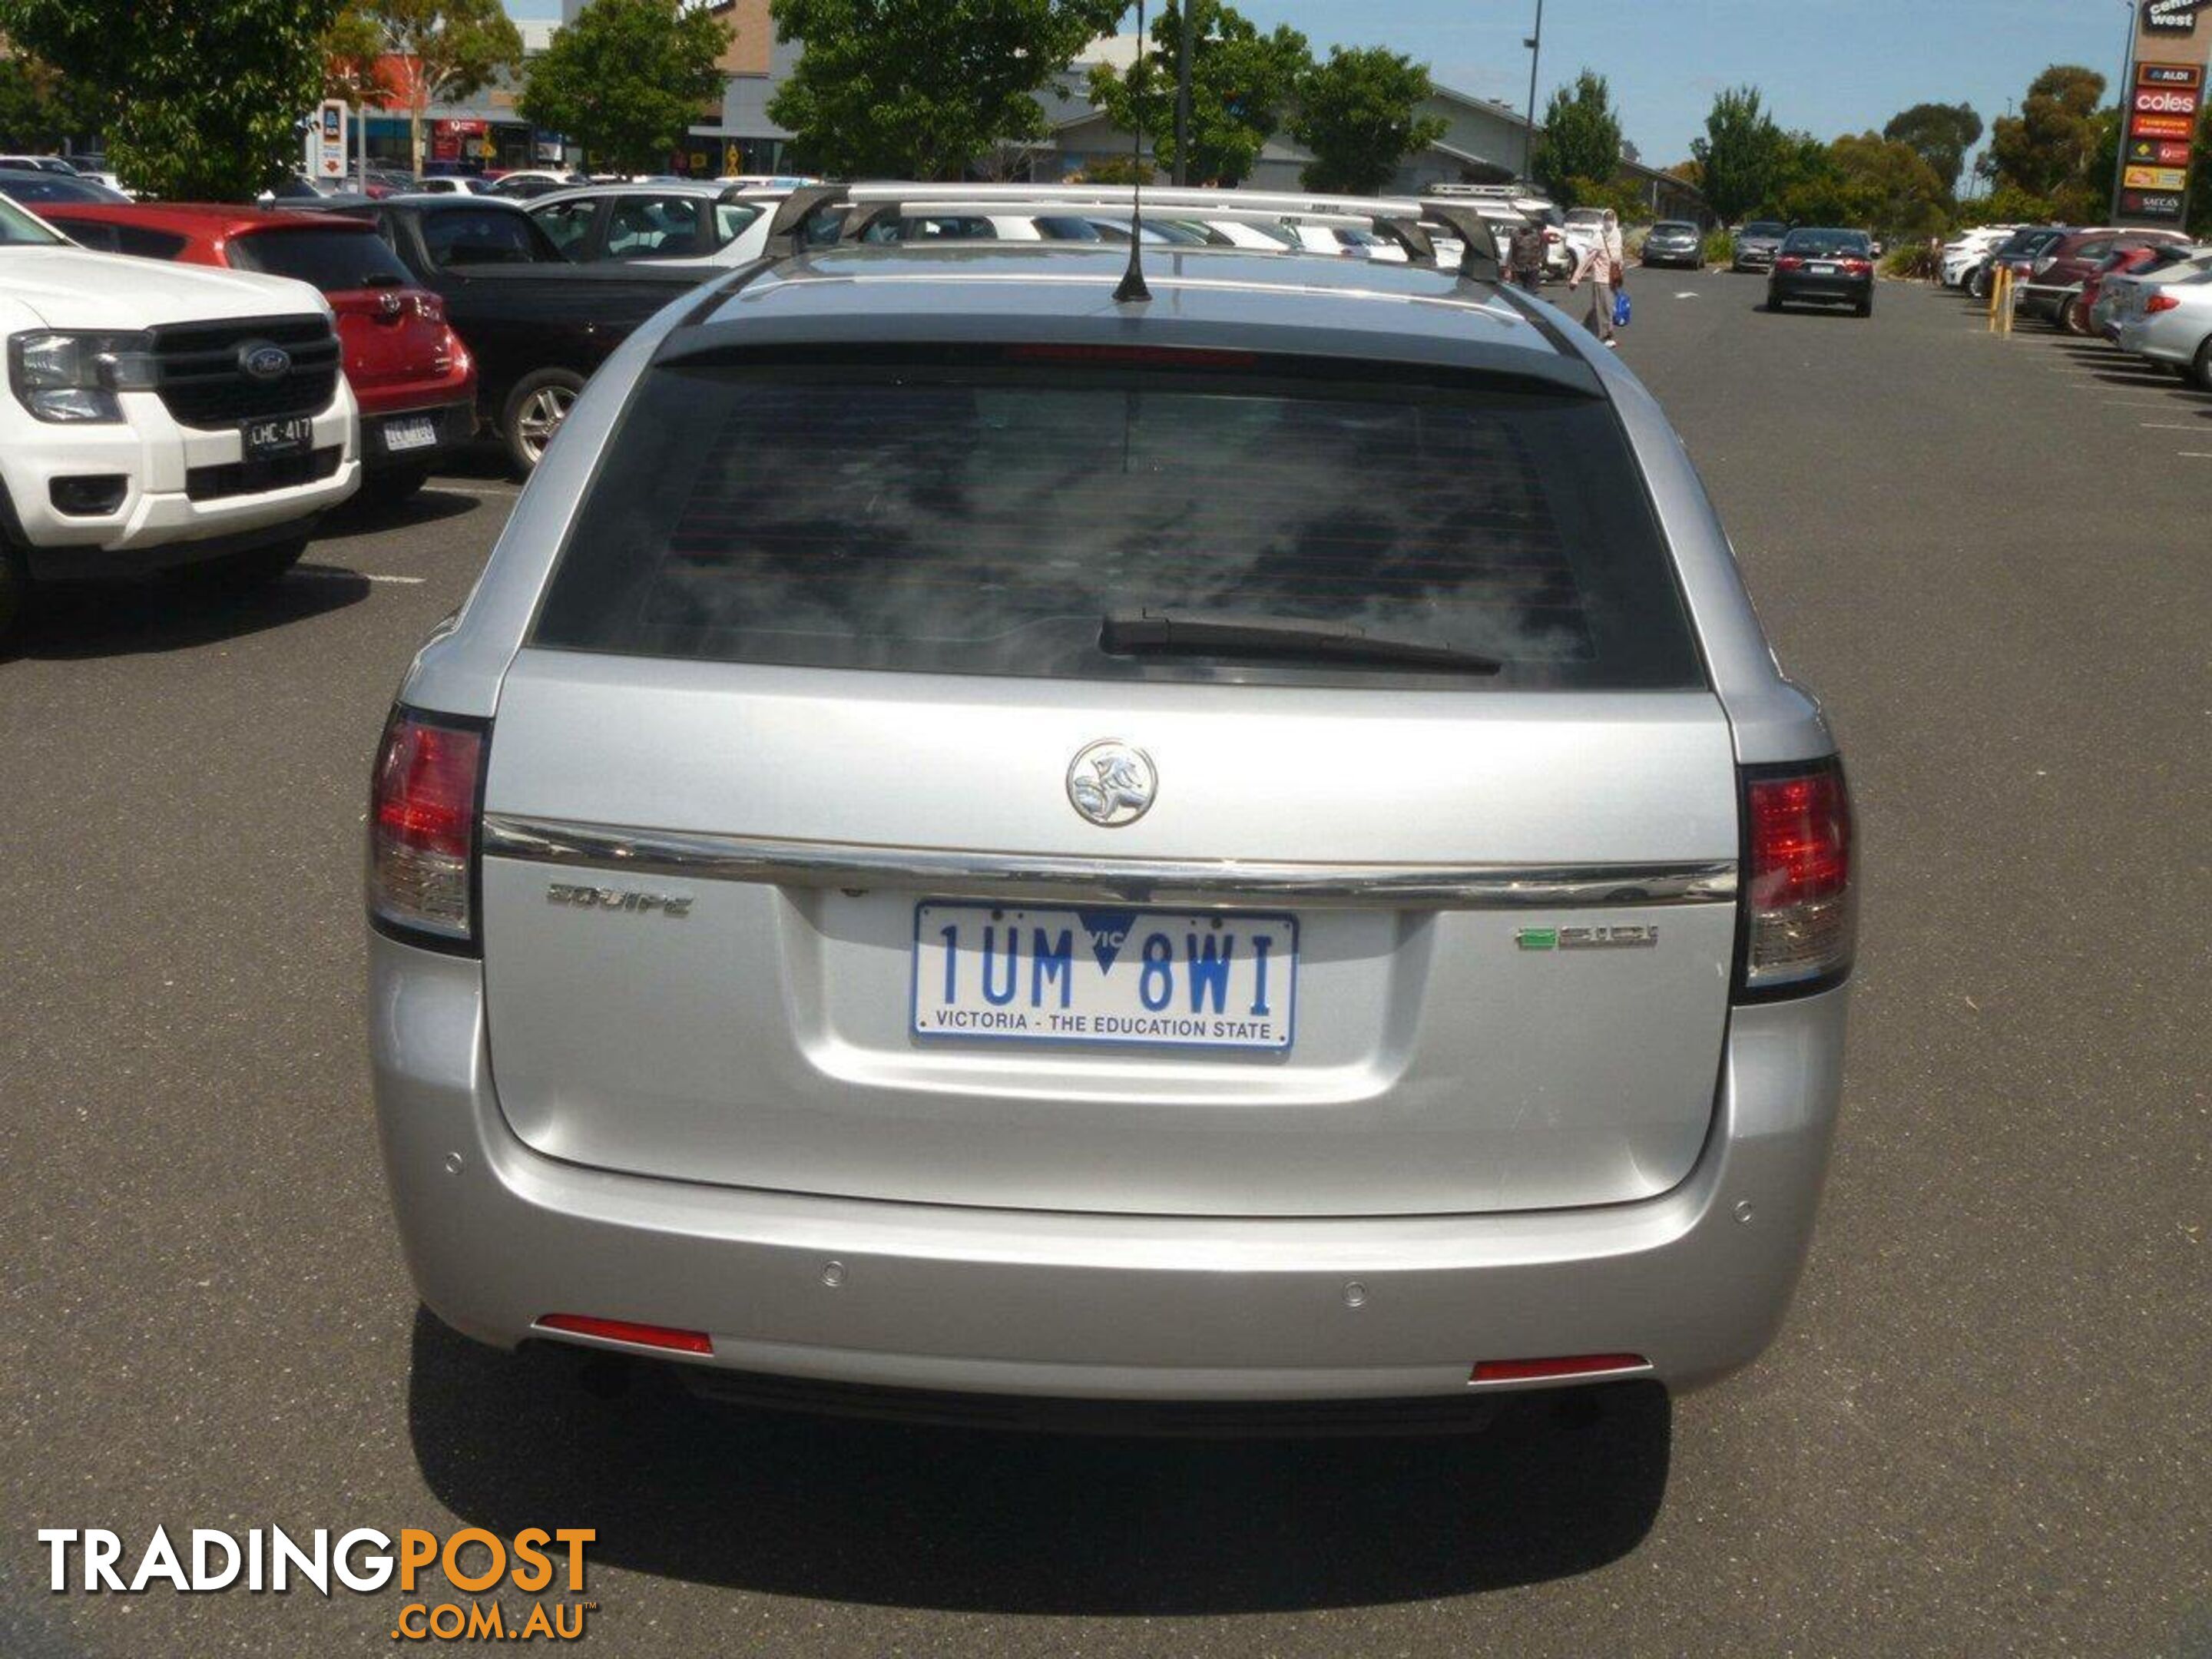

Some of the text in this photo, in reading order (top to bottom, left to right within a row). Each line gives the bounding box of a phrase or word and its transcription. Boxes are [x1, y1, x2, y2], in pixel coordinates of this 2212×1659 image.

[2151, 14, 2193, 26] west
[2162, 71, 2188, 81] ALDI
[2137, 92, 2194, 113] coles
[1086, 931, 1124, 948] VIC
[941, 926, 1273, 1016] 1UM 8WI
[936, 1010, 1027, 1029] VICTORIA
[1049, 1015, 1086, 1031] THE
[1094, 1017, 1206, 1036] EDUCATION
[1214, 1022, 1271, 1039] STATE
